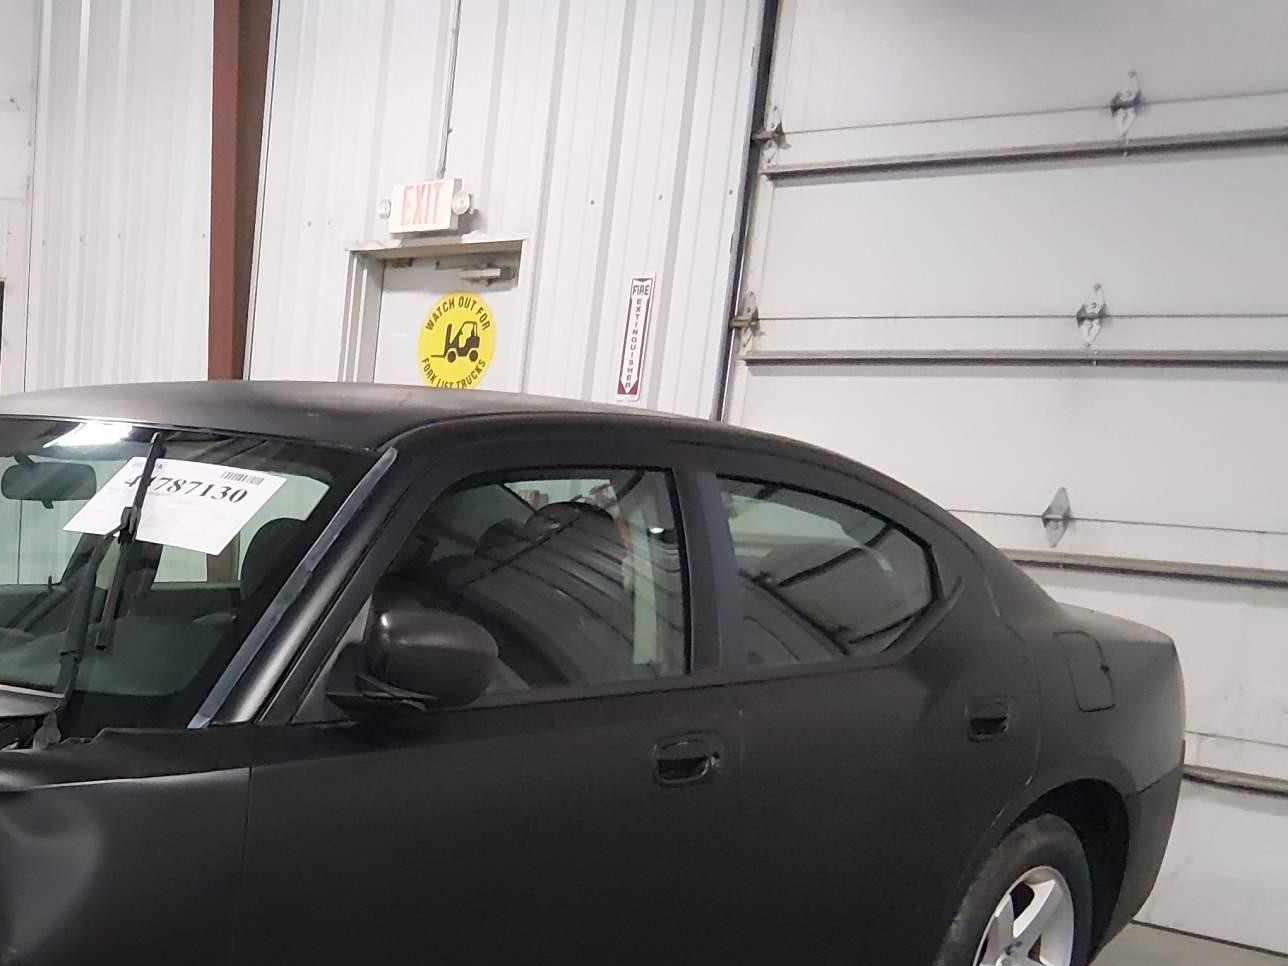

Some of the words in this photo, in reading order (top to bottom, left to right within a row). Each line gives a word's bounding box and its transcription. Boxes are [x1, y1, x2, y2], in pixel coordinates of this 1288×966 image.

[400, 182, 444, 226] EXIT
[632, 284, 650, 296] FIRE
[425, 297, 455, 331] WATCH
[458, 296, 477, 311] OUT
[475, 306, 490, 331] FOR
[625, 298, 642, 389] EXTINGUISHER
[421, 357, 437, 384] FORK
[456, 359, 486, 389] TRUCKS
[124, 475, 248, 503] 4787130
